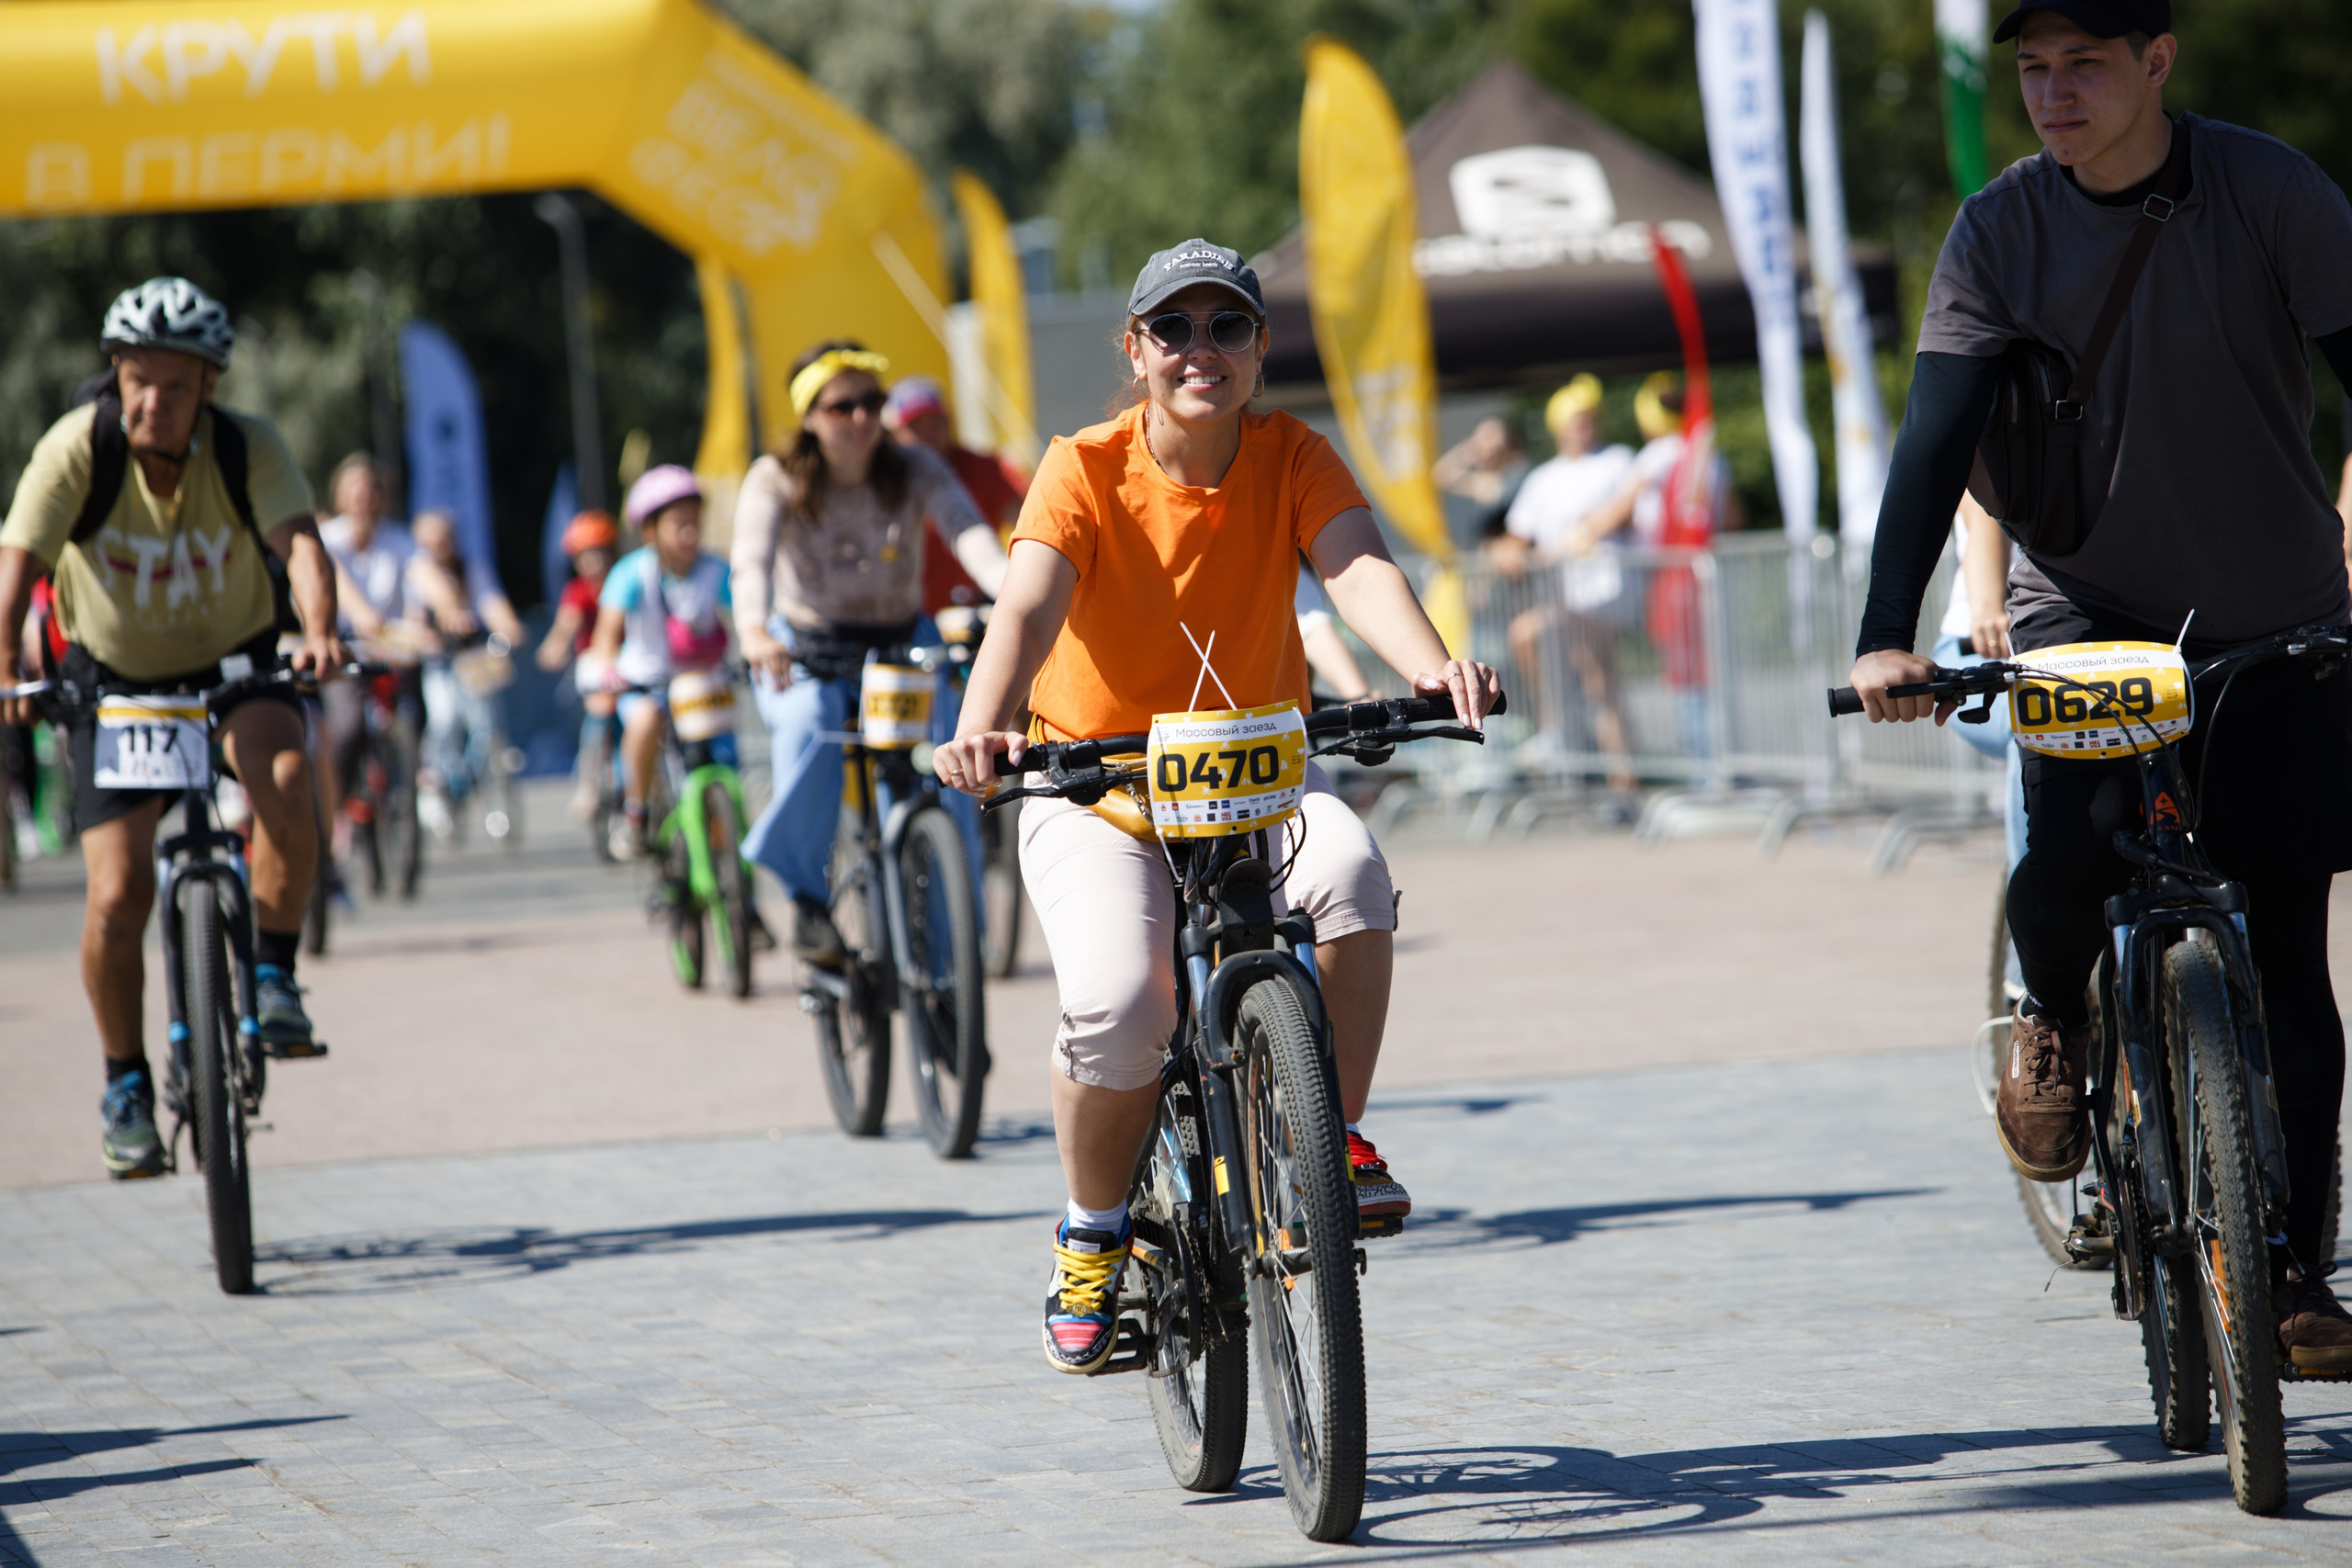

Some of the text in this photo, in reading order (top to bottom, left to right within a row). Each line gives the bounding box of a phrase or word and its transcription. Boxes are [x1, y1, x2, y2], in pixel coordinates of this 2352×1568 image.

[95, 7, 434, 108] КРУТИ
[122, 111, 513, 204] ПЕРМИ!
[1163, 250, 1234, 272] PARADISE
[93, 525, 232, 610] STAY
[2038, 656, 2108, 671] Массовый
[2110, 655, 2150, 665] заезд
[2018, 677, 2154, 727] 0629
[124, 724, 178, 754] 117
[1175, 726, 1239, 739] Массовый
[1242, 722, 1277, 734] заезд
[1157, 745, 1280, 793] 0470
